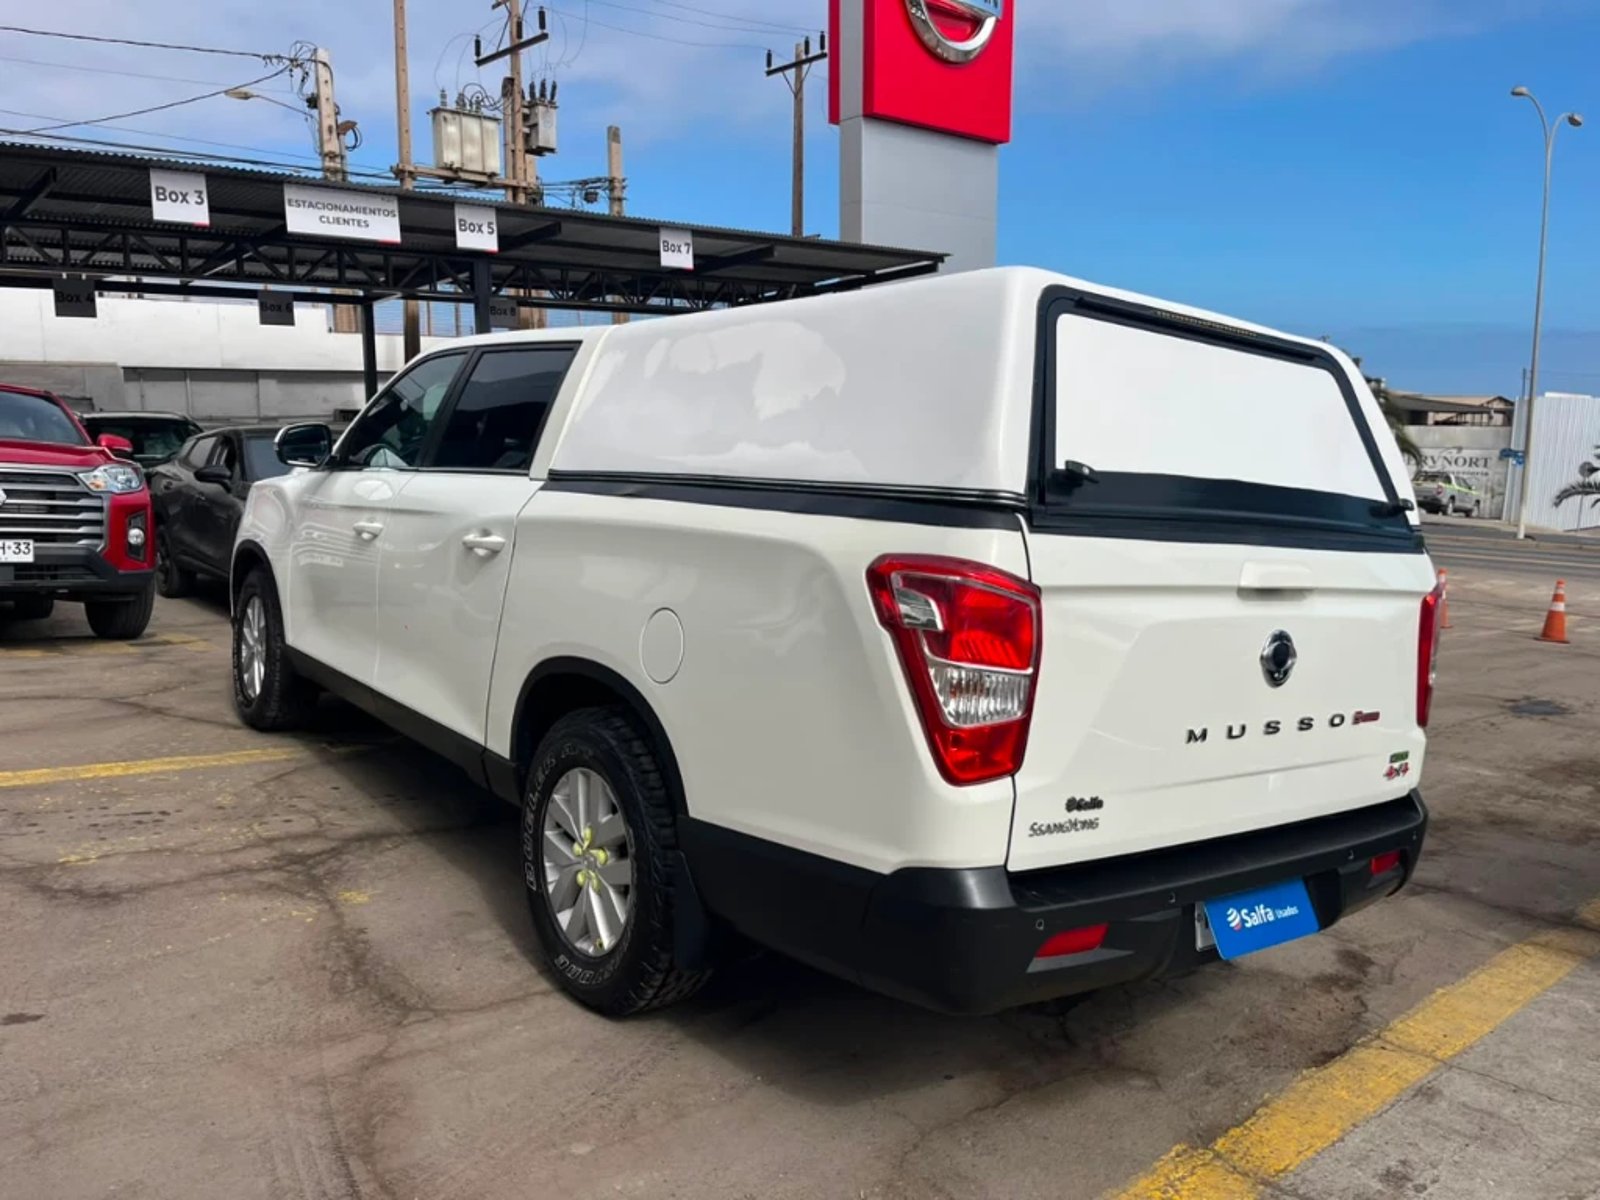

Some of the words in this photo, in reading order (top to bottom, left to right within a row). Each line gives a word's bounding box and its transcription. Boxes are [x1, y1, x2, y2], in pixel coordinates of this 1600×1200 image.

[155, 186, 190, 204] Box
[194, 190, 205, 206] 3
[287, 199, 397, 217] ESTACIONAMIENTOS
[319, 215, 370, 228] CLIENTES
[458, 218, 484, 234] Box
[487, 221, 495, 235] 5
[662, 240, 682, 254] Box
[684, 242, 691, 255] 7
[55, 291, 82, 304] Box
[260, 300, 282, 312] Box
[489, 305, 508, 316] Box
[1186, 713, 1345, 744] MUSSO
[1240, 904, 1275, 929] Salfa
